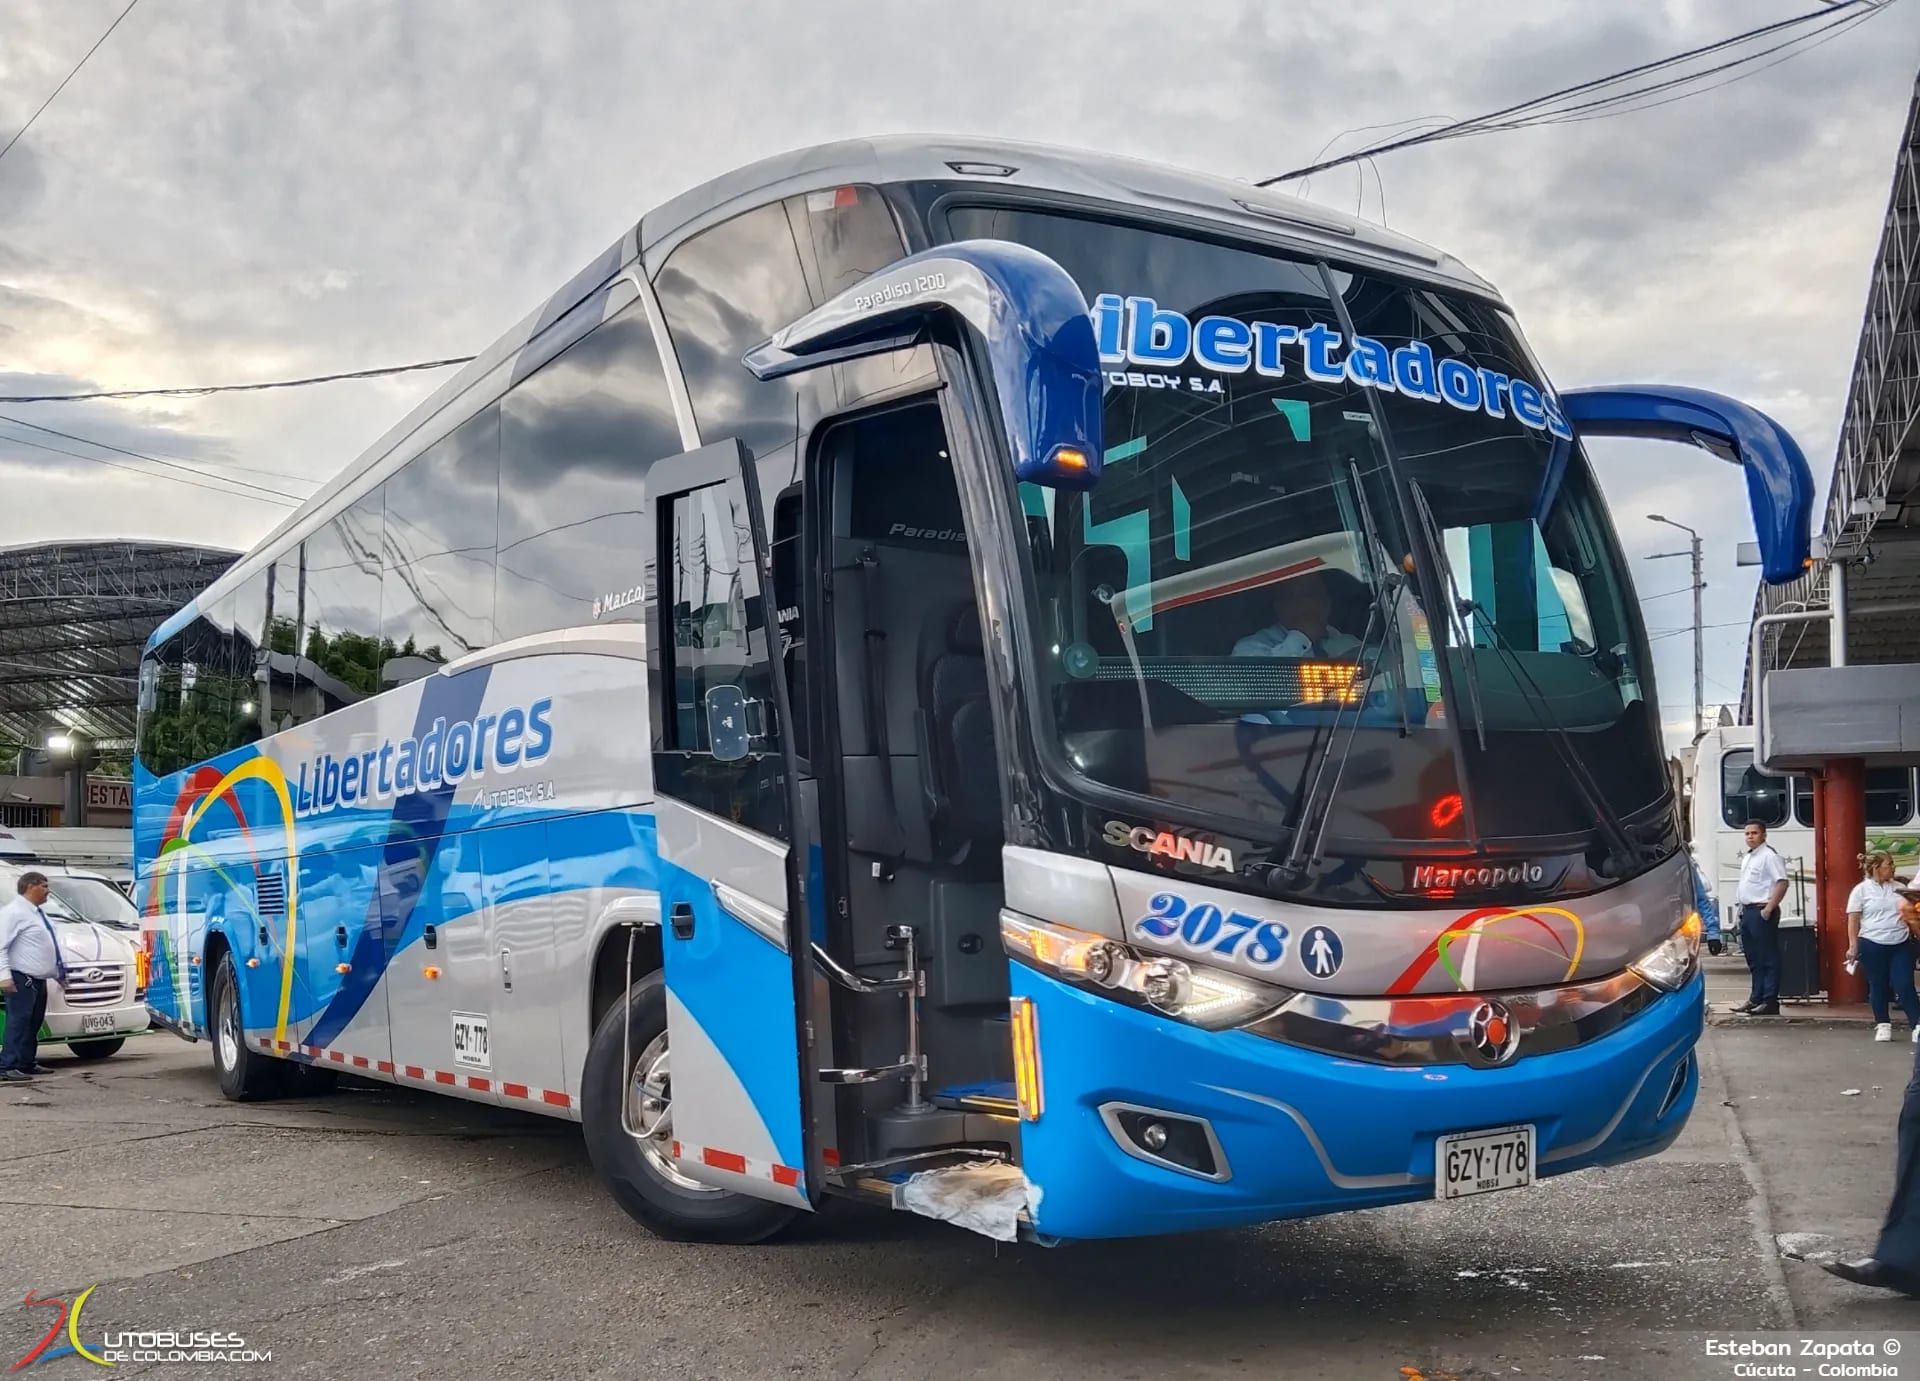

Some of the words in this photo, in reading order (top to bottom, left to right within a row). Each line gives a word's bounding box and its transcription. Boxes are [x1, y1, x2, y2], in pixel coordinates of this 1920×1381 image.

[855, 281, 912, 311] Paradiso
[915, 273, 945, 292] 1200
[1089, 293, 1573, 441] ibertadores
[1189, 377, 1226, 393] S.A.
[889, 523, 967, 542] Paradis
[777, 605, 799, 624] NIA
[295, 695, 553, 818] Libertadores
[88, 784, 133, 806] ESTA
[471, 785, 533, 813] AUTOBOY
[1103, 820, 1235, 873] SCANIA
[1413, 861, 1543, 889] Marcopolo
[1132, 891, 1291, 971] 2078
